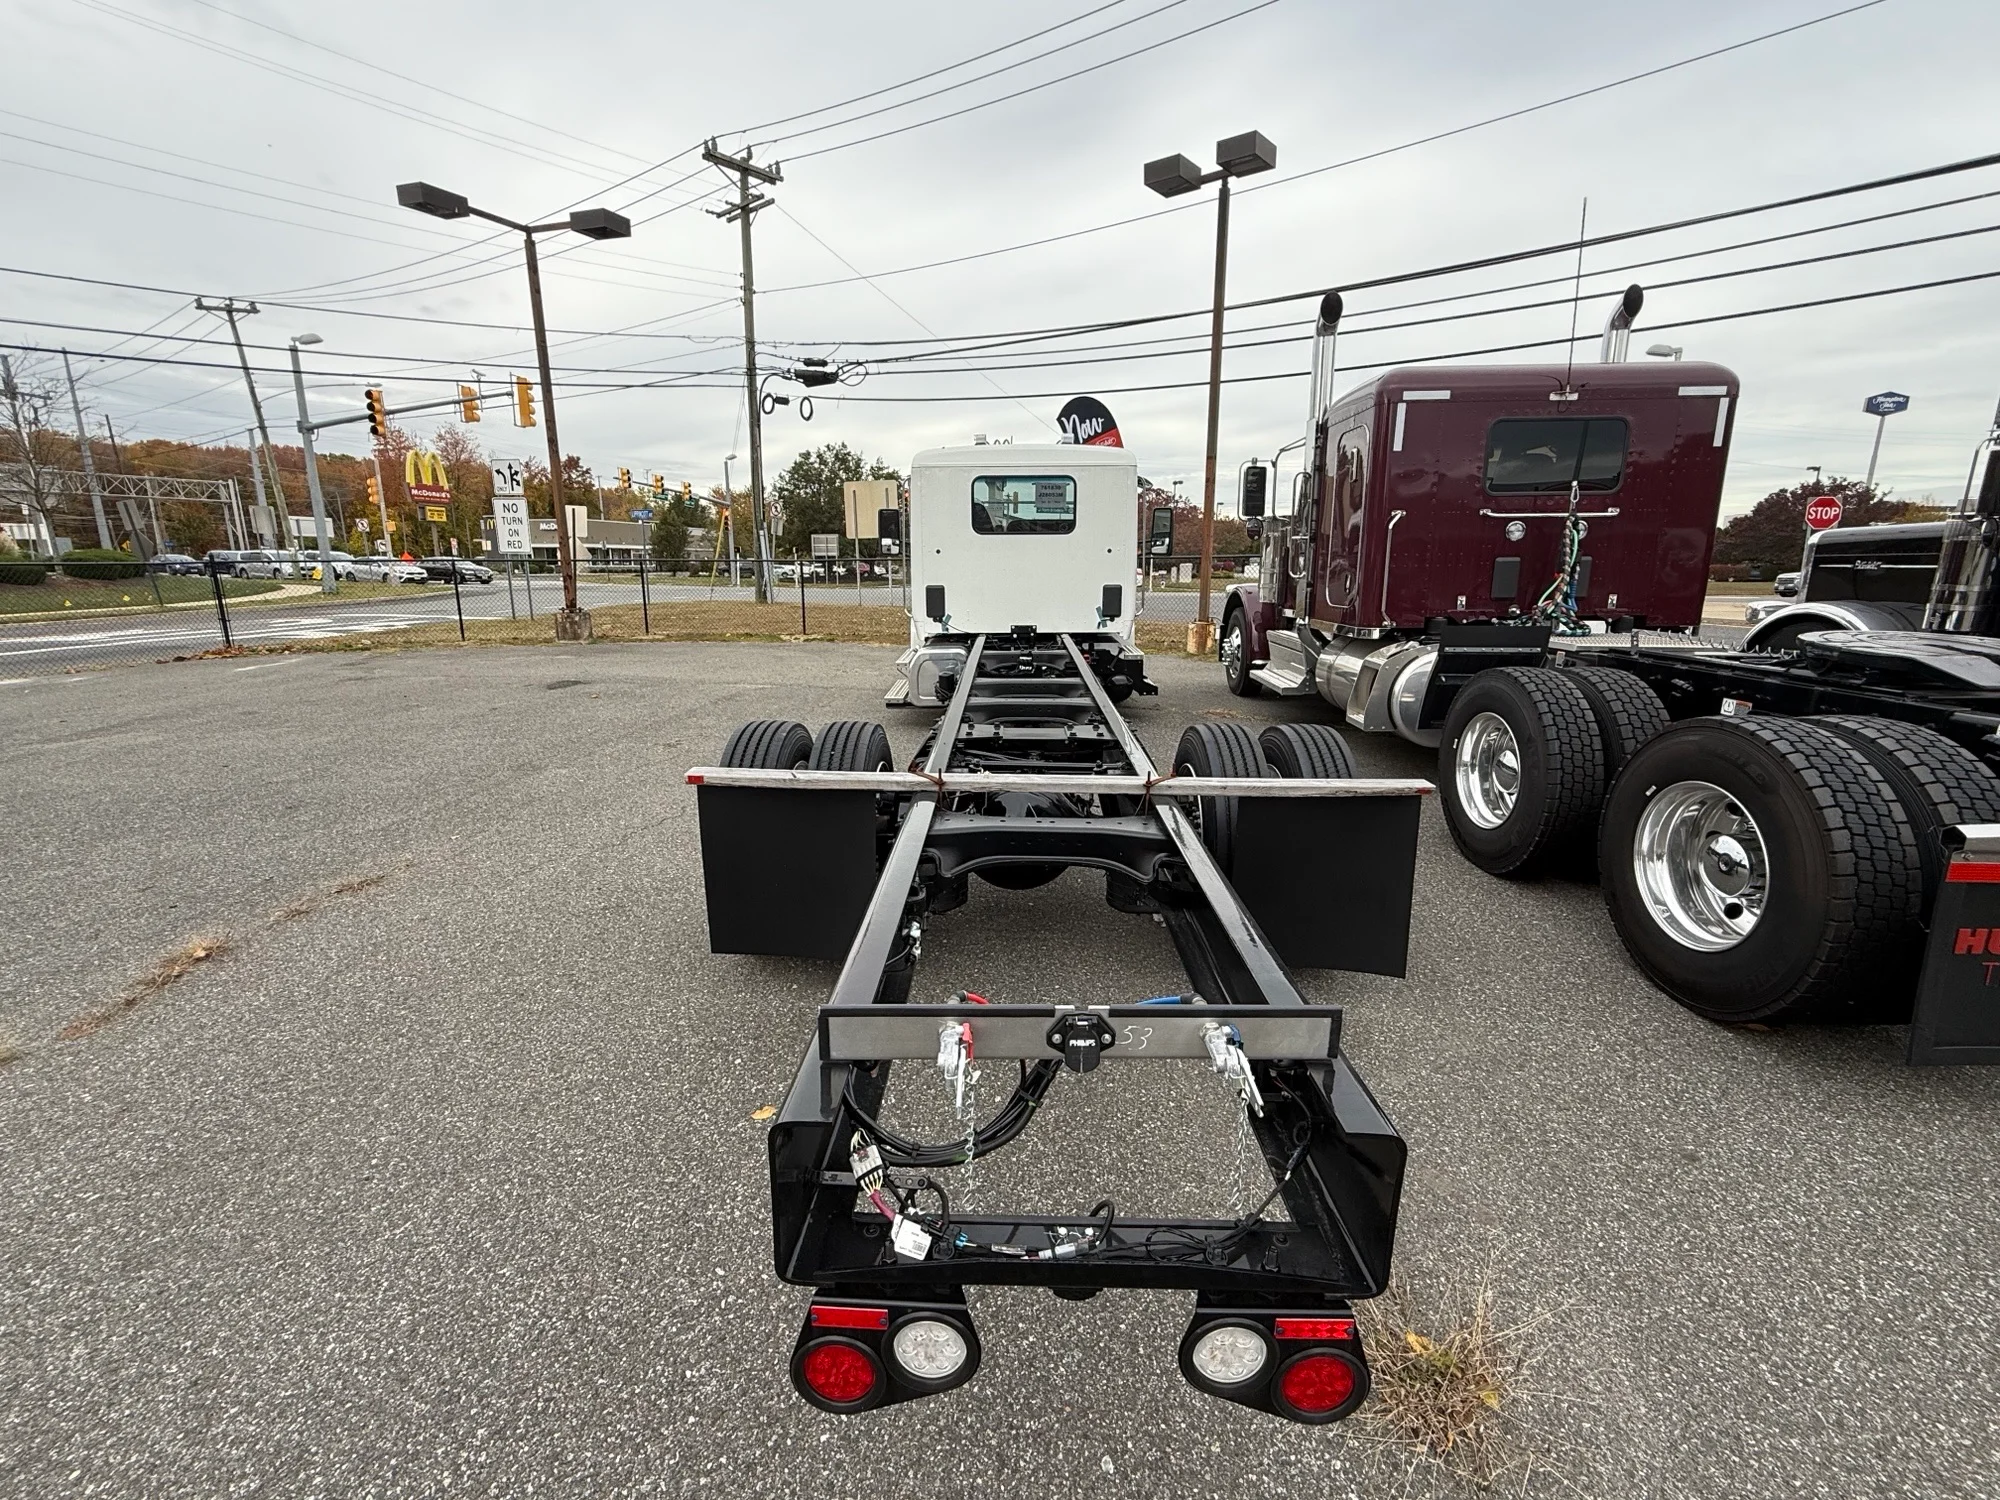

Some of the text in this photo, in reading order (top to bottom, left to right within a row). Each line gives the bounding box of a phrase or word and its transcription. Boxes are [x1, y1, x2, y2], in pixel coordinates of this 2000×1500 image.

[1061, 414, 1104, 444] Now
[411, 488, 451, 498] McDonald's
[502, 503, 519, 513] NO
[1808, 507, 1840, 519] STOP
[501, 516, 523, 525] TURN
[508, 528, 520, 537] ON
[507, 540, 523, 549] RED
[1115, 1025, 1153, 1051] 53
